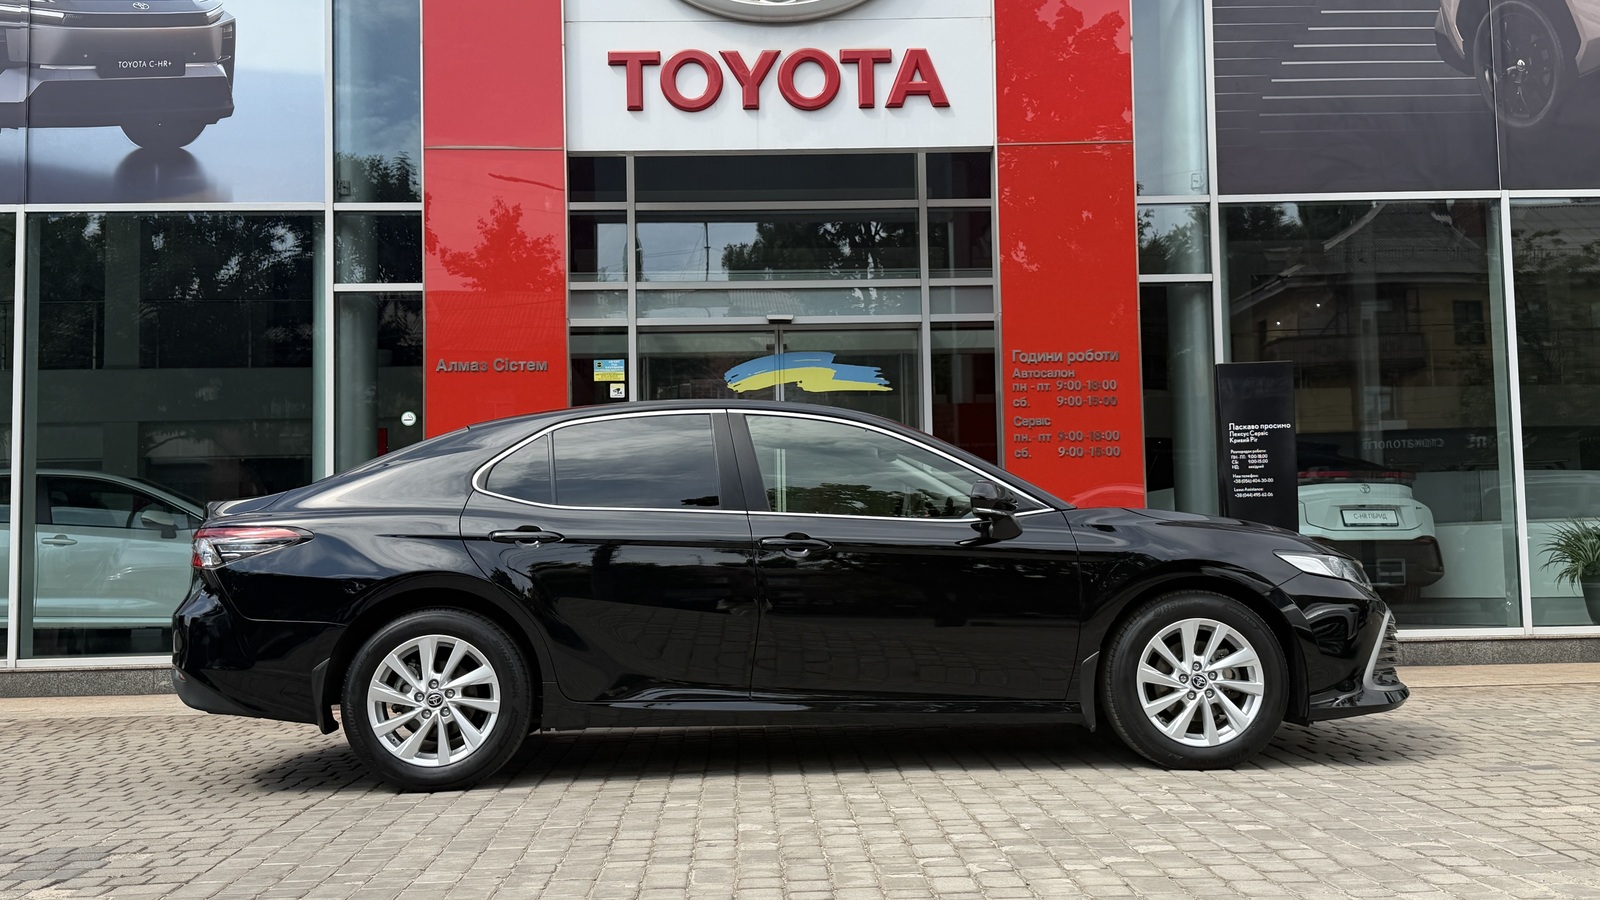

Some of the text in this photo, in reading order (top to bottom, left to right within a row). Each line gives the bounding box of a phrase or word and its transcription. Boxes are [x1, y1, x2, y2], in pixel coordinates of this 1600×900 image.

[118, 60, 172, 69] TOYOTA C-HR+
[608, 48, 950, 112] TOYOTA
[1011, 349, 1119, 365] Години роботи
[435, 357, 548, 372] Алмаз Сістем
[1012, 368, 1075, 379] Автосалон
[1013, 396, 1031, 408] сб.
[1013, 416, 1052, 429] Сервіс
[1014, 448, 1032, 459] сб.
